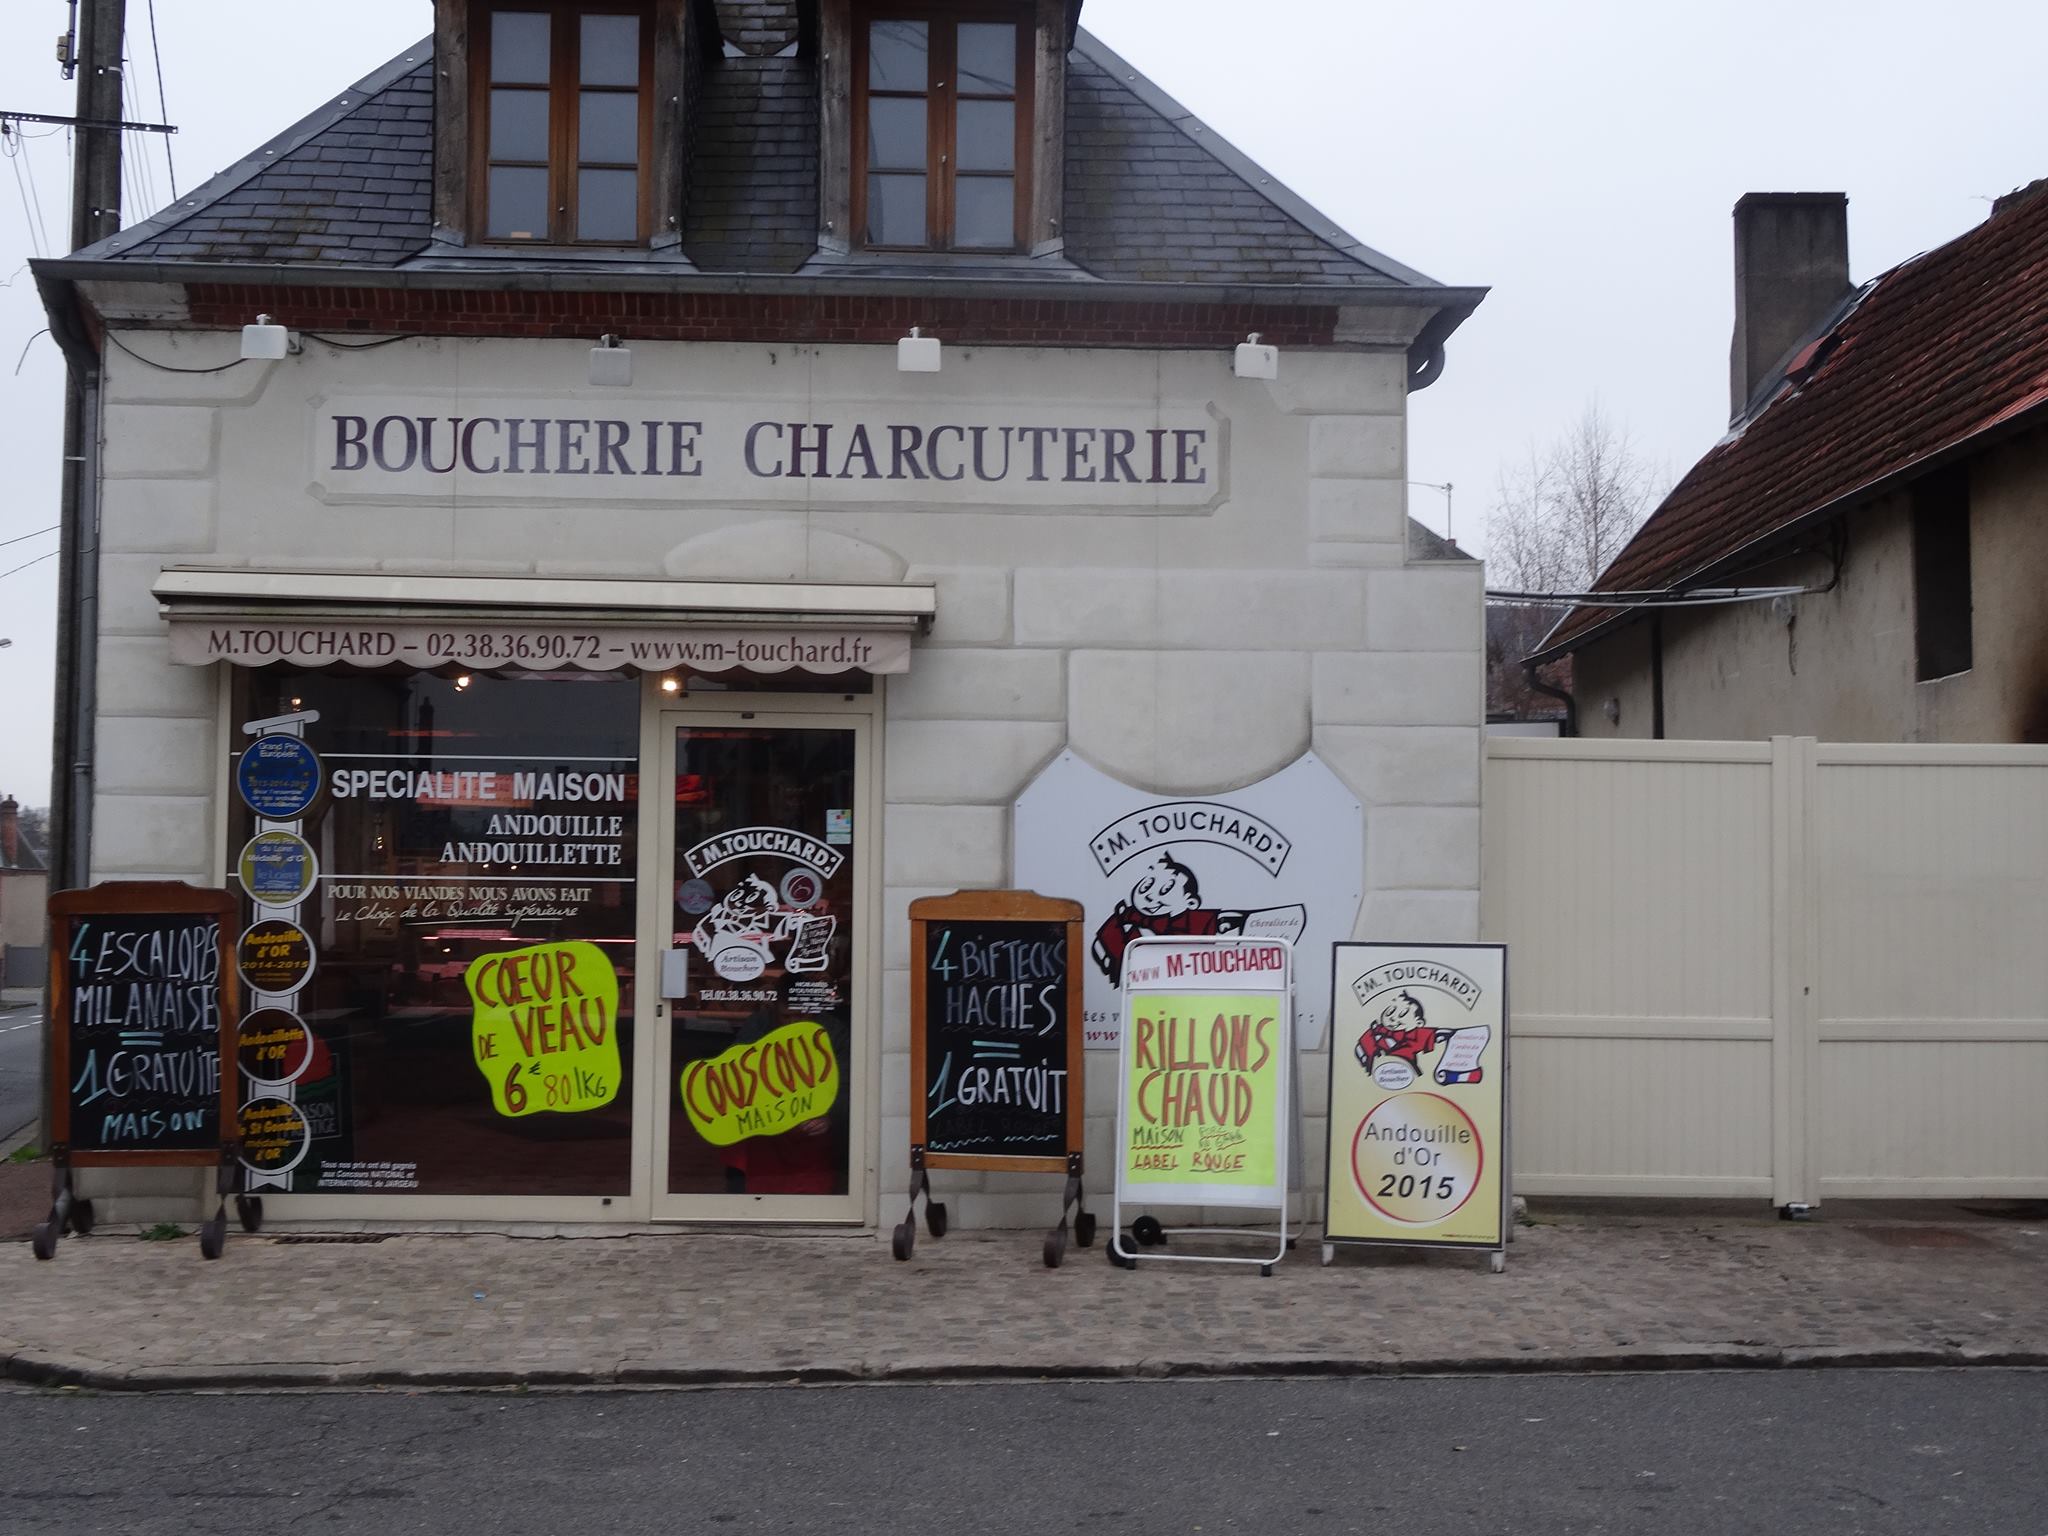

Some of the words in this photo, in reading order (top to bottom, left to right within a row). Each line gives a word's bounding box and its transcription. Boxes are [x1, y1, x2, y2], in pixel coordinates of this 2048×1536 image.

[331, 415, 702, 476] BOUCHERIE
[744, 422, 1206, 483] CHARCUTERIE
[208, 630, 395, 656] M.TOUCHARD
[427, 633, 600, 659] 02.38.36.90.72
[632, 636, 872, 663] www.m-touchard.fr
[332, 769, 497, 799] SPECIALITE
[513, 772, 624, 801] MAISON
[486, 814, 623, 837] ANDOUILLE
[1107, 832, 1136, 857] M.
[1139, 811, 1273, 855] TOUCHARD
[440, 842, 622, 865] ANDOUILLETTE
[702, 831, 830, 868] M.TOUCHARD
[328, 885, 366, 899] POUR
[371, 886, 399, 900] NOS
[404, 886, 464, 900] VIANDES
[468, 887, 507, 901] NOUS
[511, 887, 559, 901] AVONS
[561, 888, 592, 901] FAIT
[400, 903, 417, 919] de
[422, 901, 440, 918] la
[69, 923, 94, 979] 4
[930, 930, 958, 981] 4
[1167, 947, 1283, 978] M-TOUCHARD
[1384, 966, 1471, 995] TOUCHARD
[478, 1033, 499, 1061] DE
[510, 996, 606, 1057] VEAU
[72, 1049, 107, 1106] 1
[686, 1028, 832, 1124] COUSCOUS
[928, 1051, 958, 1119] 1
[1137, 1070, 1253, 1128] CHAUD
[1364, 1123, 1471, 1144] Andouille
[1134, 1153, 1179, 1169] LABEL
[1192, 1152, 1247, 1169] ROUGE
[1393, 1147, 1442, 1167] d'Or
[1378, 1174, 1455, 1199] 2015
